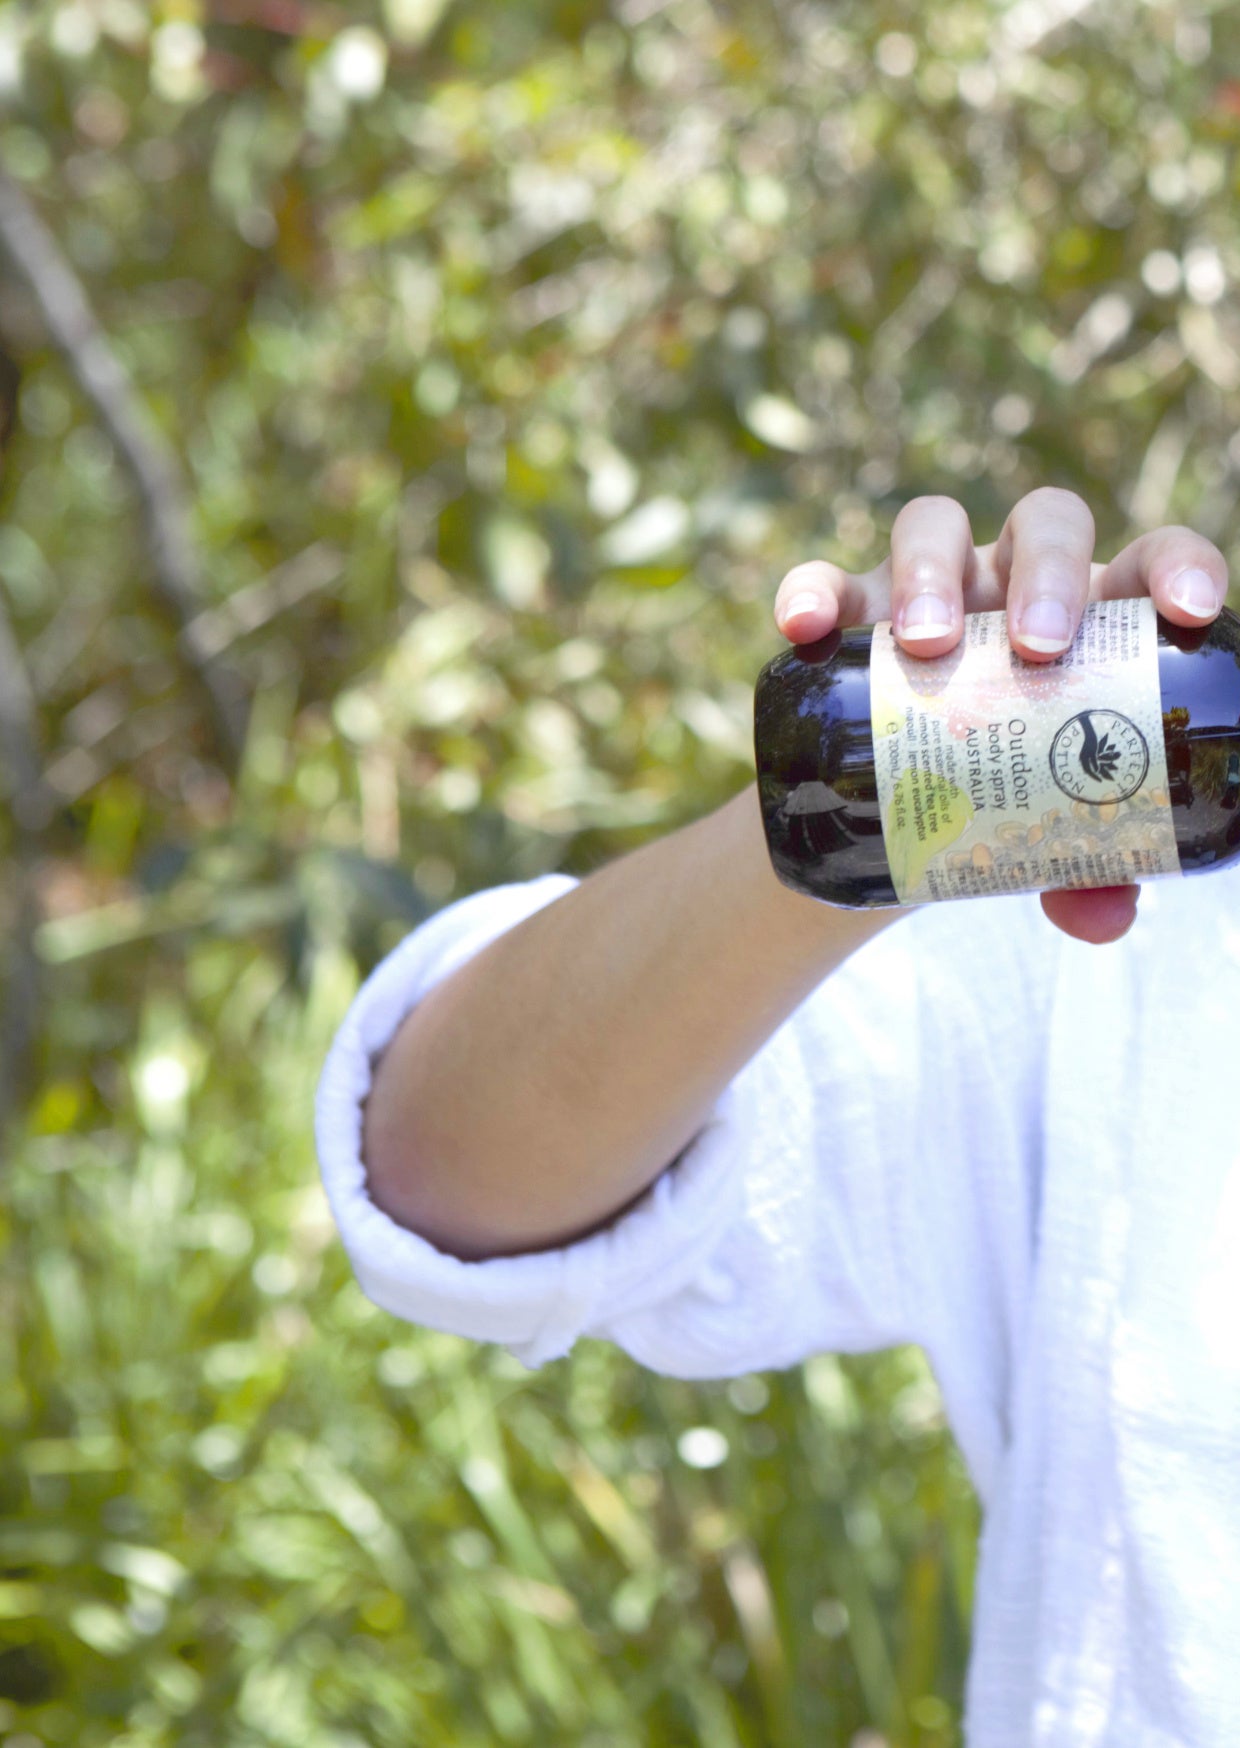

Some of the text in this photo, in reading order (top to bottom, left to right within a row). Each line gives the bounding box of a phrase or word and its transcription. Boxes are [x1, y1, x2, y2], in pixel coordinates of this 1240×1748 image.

[908, 750, 920, 785] lemon
[919, 711, 938, 833] lemon scented tea tree
[931, 720, 953, 824] pure essential oils of
[945, 744, 960, 799] made with
[965, 727, 986, 812] AUSTRALIA
[986, 723, 1007, 811] body spray
[1008, 719, 1033, 811] Outdoor
[1057, 725, 1086, 795] POTION
[1111, 720, 1141, 794] PERFECT
[912, 787, 926, 841] eucalyptus
